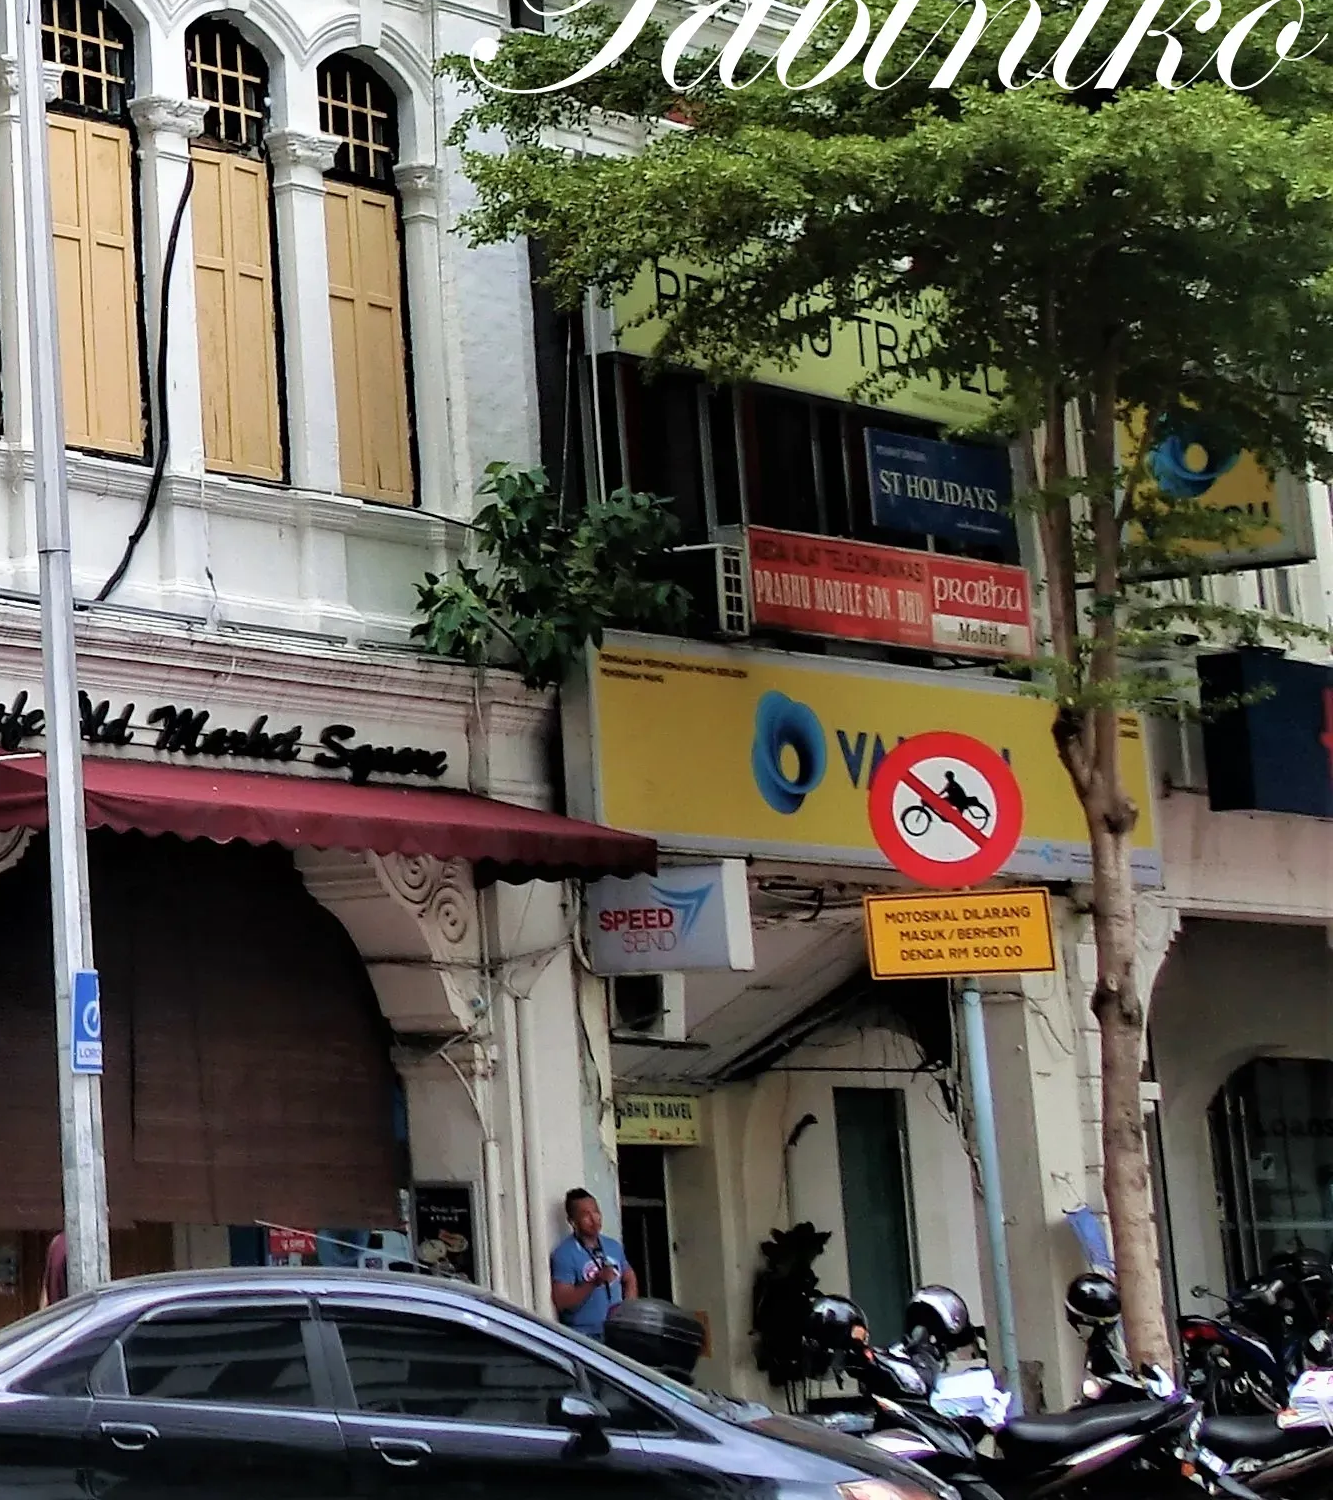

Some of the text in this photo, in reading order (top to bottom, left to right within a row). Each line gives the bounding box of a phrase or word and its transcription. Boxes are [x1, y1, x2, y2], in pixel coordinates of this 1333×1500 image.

[879, 469, 998, 512] ST HOLIDAYS
[754, 569, 810, 609] PRABHU
[814, 578, 864, 617] MOBILE
[956, 621, 1009, 647] Mobile
[147, 704, 303, 762] Market
[313, 723, 449, 787] Square
[599, 908, 674, 932] SPEED
[885, 906, 1031, 924] MOTOSIKAL DILARANG
[622, 930, 677, 953] SEND
[899, 928, 946, 942] MASUK
[957, 926, 1020, 940] BERHENTI
[900, 945, 1023, 962] DENDA RM 500.00
[653, 1102, 692, 1120] TRAVEL
